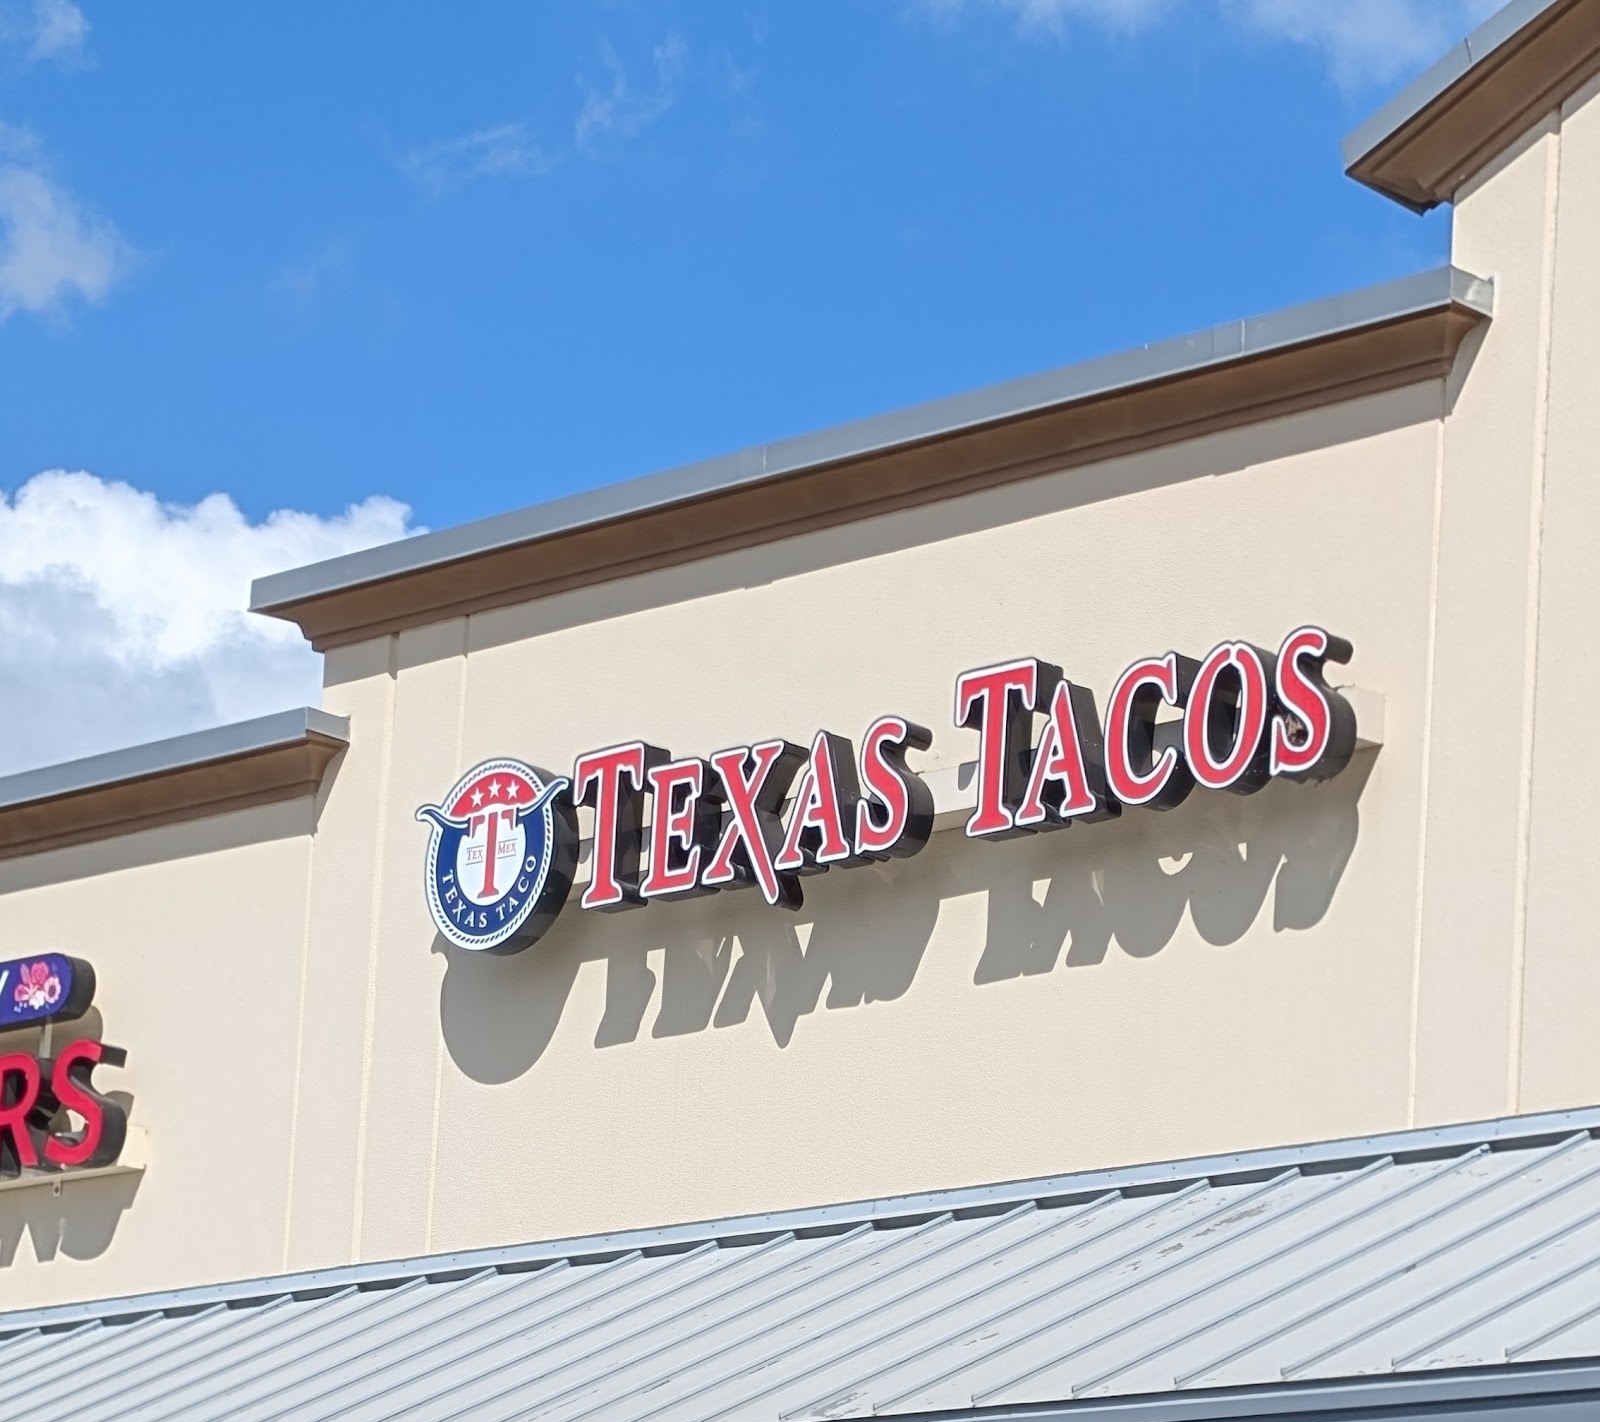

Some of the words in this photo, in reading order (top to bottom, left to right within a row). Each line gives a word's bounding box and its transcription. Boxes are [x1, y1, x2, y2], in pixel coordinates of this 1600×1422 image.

[574, 715, 914, 910] TEXAS
[955, 626, 1334, 838] TACOS
[442, 868, 488, 929] TEXAS
[495, 855, 537, 922] TACO
